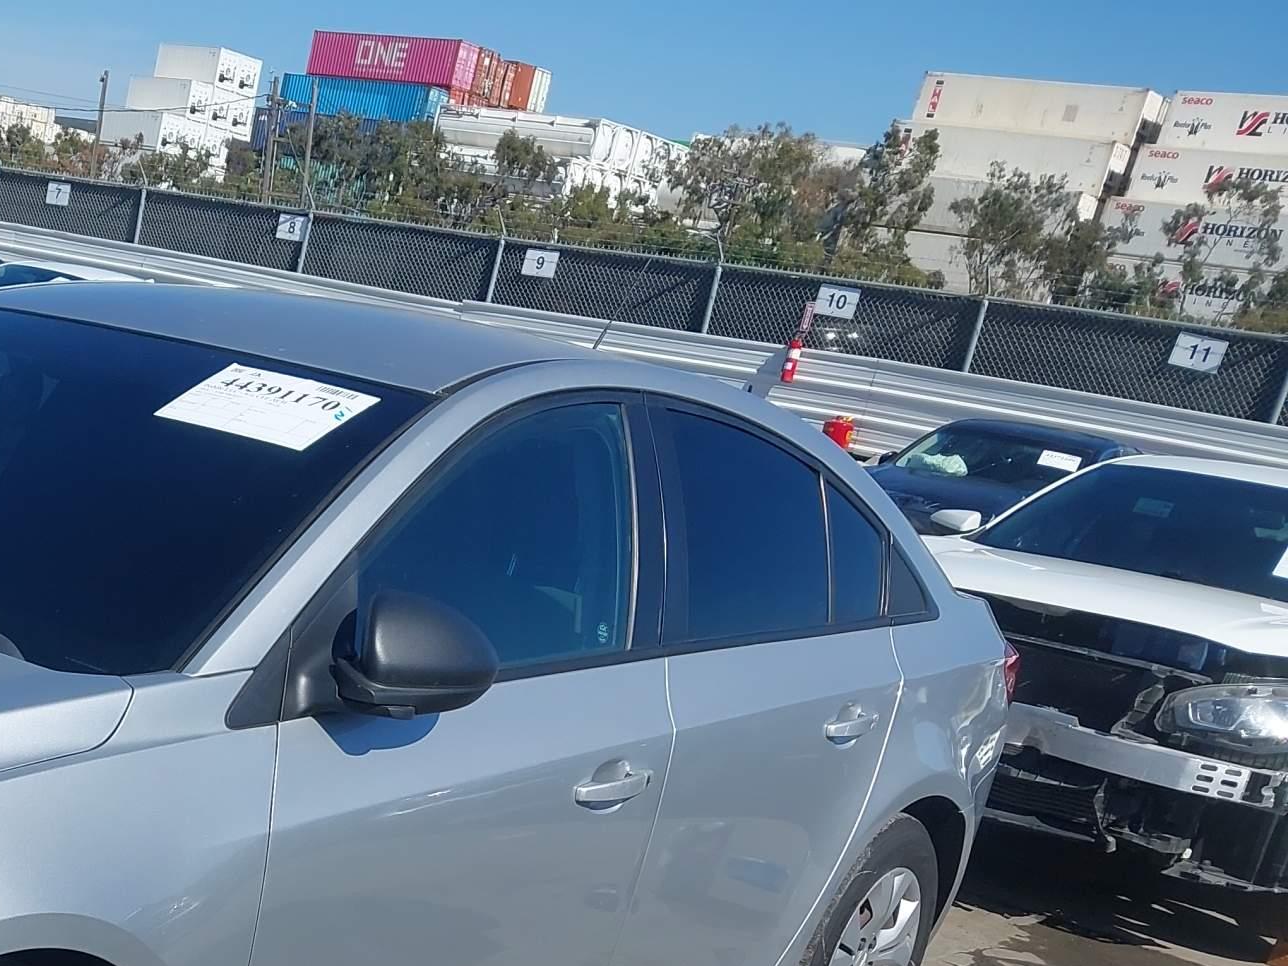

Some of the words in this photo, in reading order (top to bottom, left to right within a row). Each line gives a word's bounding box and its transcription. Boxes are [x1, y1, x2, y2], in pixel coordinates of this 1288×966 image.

[356, 40, 409, 68] ONE
[1181, 96, 1213, 106] seaco
[1147, 150, 1179, 160] seaco
[55, 186, 62, 199] 7
[288, 221, 295, 233] 8
[536, 256, 545, 270] 9
[829, 292, 848, 310] 10
[1189, 344, 1212, 362] 11
[221, 378, 341, 412] 44391170
